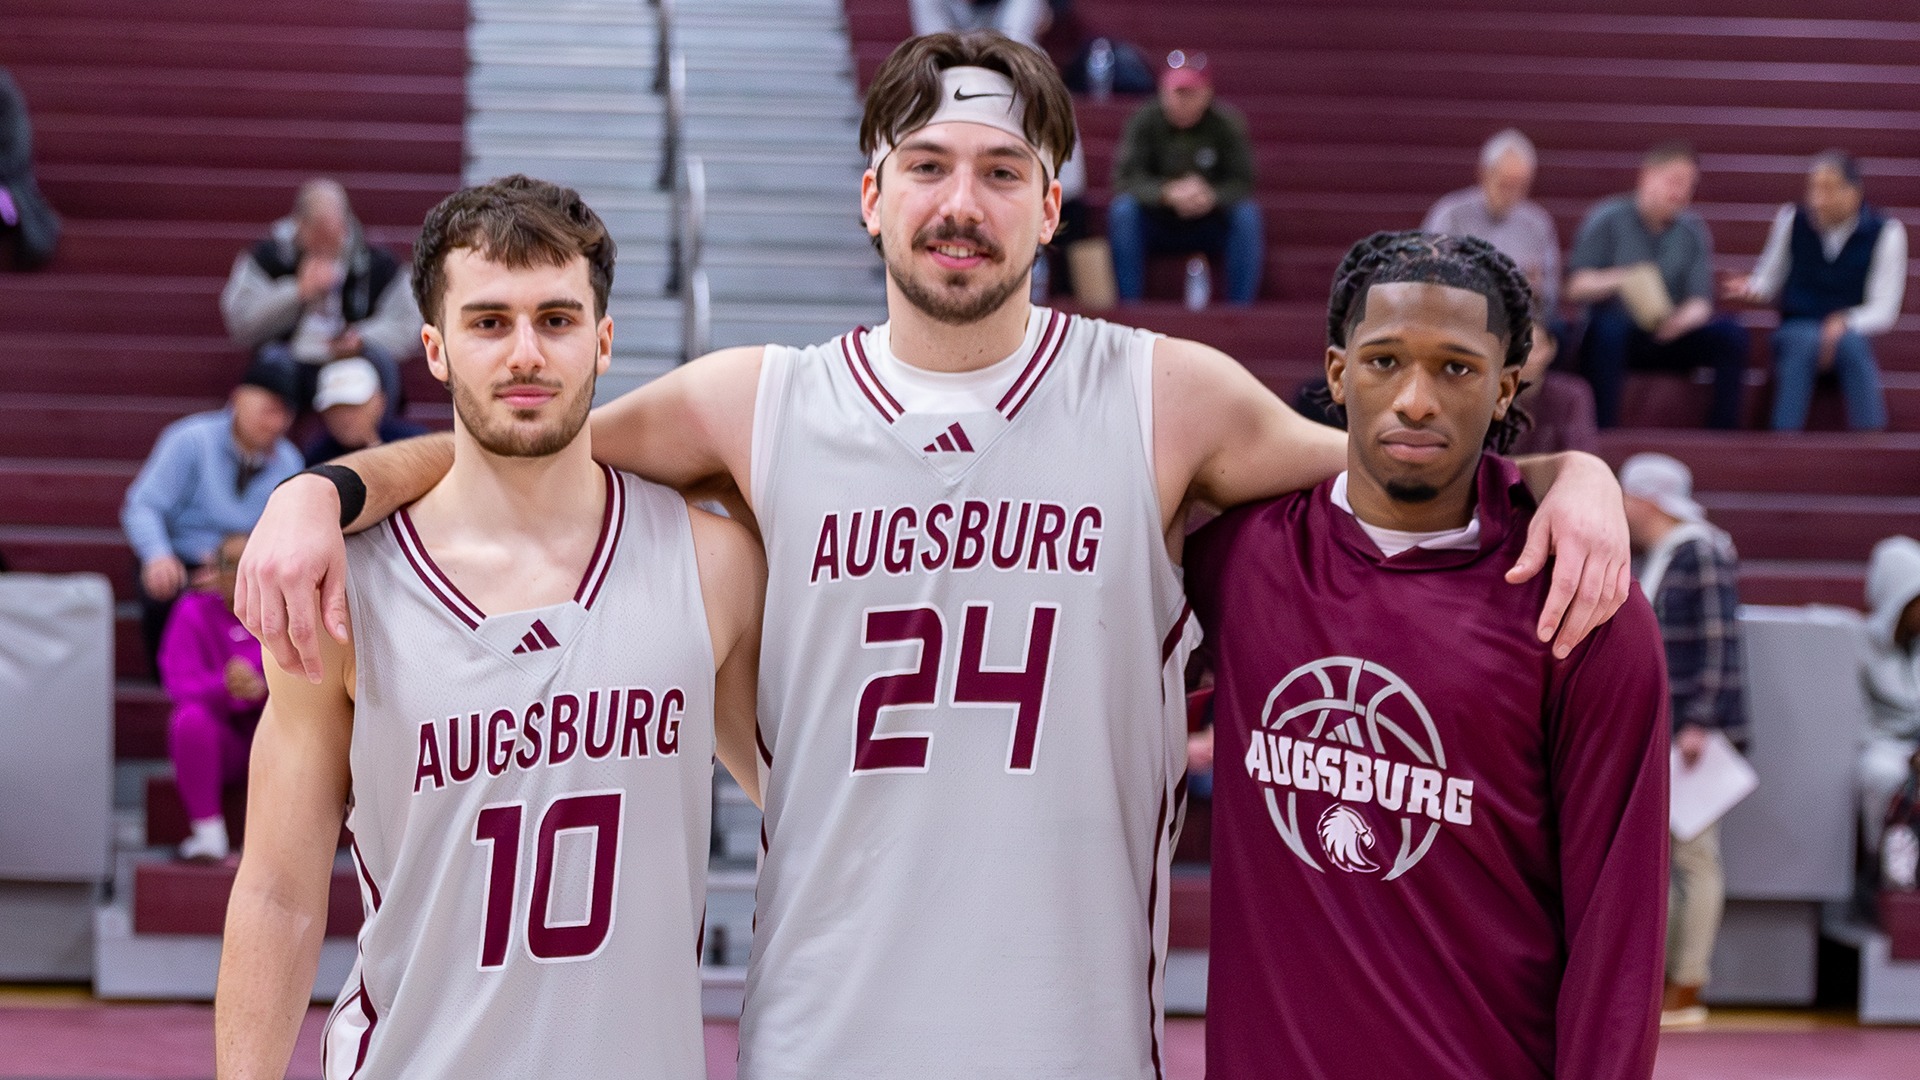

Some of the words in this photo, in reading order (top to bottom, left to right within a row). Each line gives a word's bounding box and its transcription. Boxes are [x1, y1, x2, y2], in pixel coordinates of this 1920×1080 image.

[808, 497, 1105, 586] AUGSBURG
[412, 686, 688, 795] AUGSBURG
[849, 600, 1061, 777] 24
[1245, 730, 1474, 826] AUGSBURG
[471, 789, 626, 972] 10
